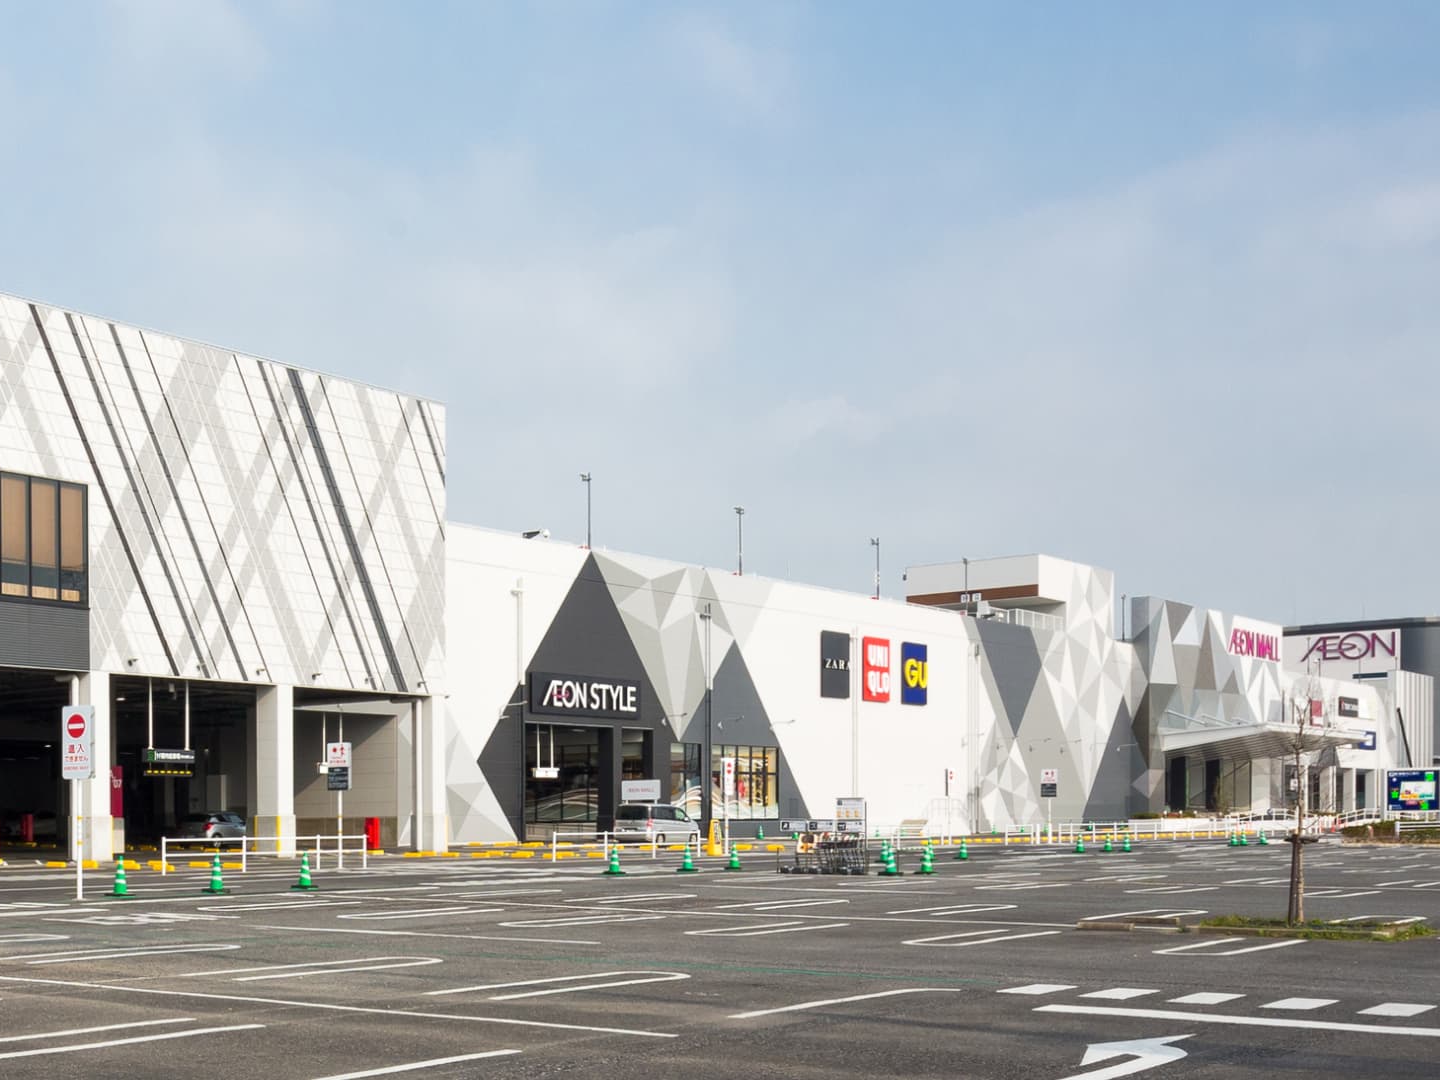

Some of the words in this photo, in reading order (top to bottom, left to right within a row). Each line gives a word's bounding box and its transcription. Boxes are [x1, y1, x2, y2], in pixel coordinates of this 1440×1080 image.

[867, 644, 889, 668] UNI
[1256, 632, 1281, 662] MALL
[825, 658, 851, 671] ZARA
[904, 659, 928, 688] GU
[590, 683, 637, 712] STYLE
[867, 670, 890, 697] QLO
